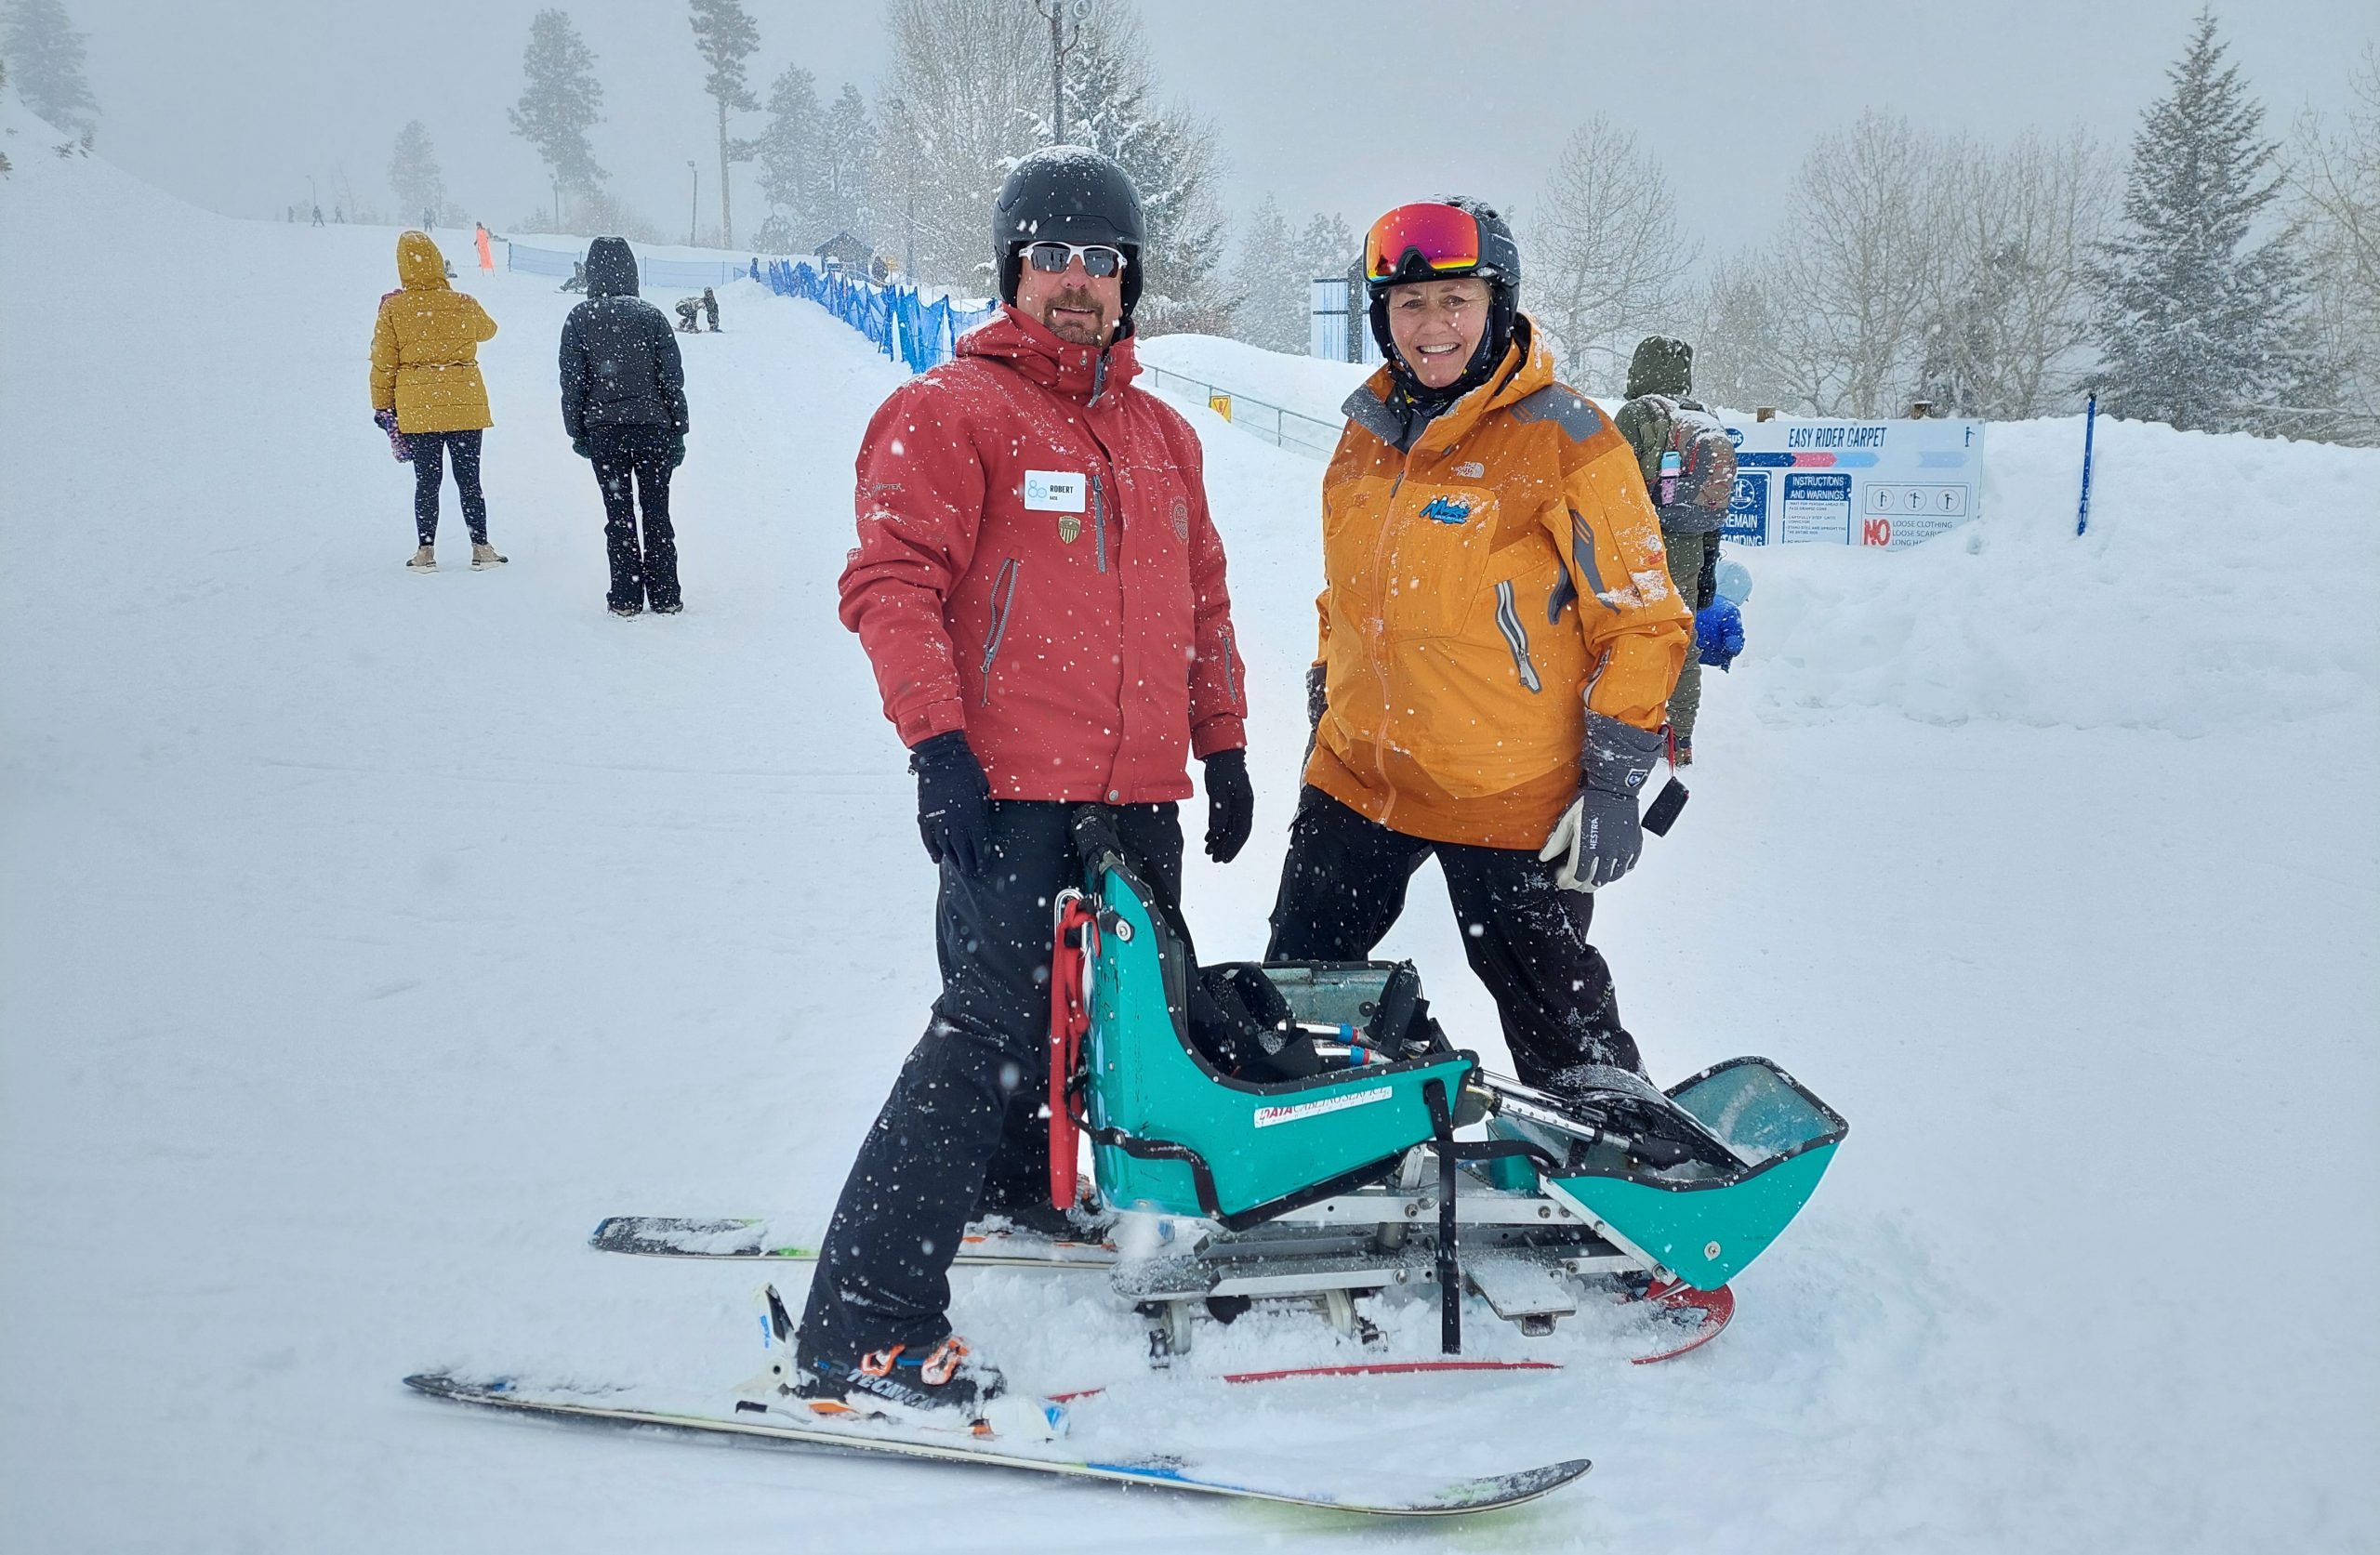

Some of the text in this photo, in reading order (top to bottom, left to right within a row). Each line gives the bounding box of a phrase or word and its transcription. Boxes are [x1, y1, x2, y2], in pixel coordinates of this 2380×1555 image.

[1788, 427, 1887, 447] EASY RIDER CARPET
[1792, 476, 1844, 487] INSTRUCTIONS
[1050, 484, 1074, 494] ROBERT
[1790, 490, 1845, 500] AND WARNINGS
[1864, 519, 1953, 546] NO LOOSE CLOTHING
[1892, 529, 1915, 537] LOOSE
[1589, 817, 1599, 850] HESTRA
